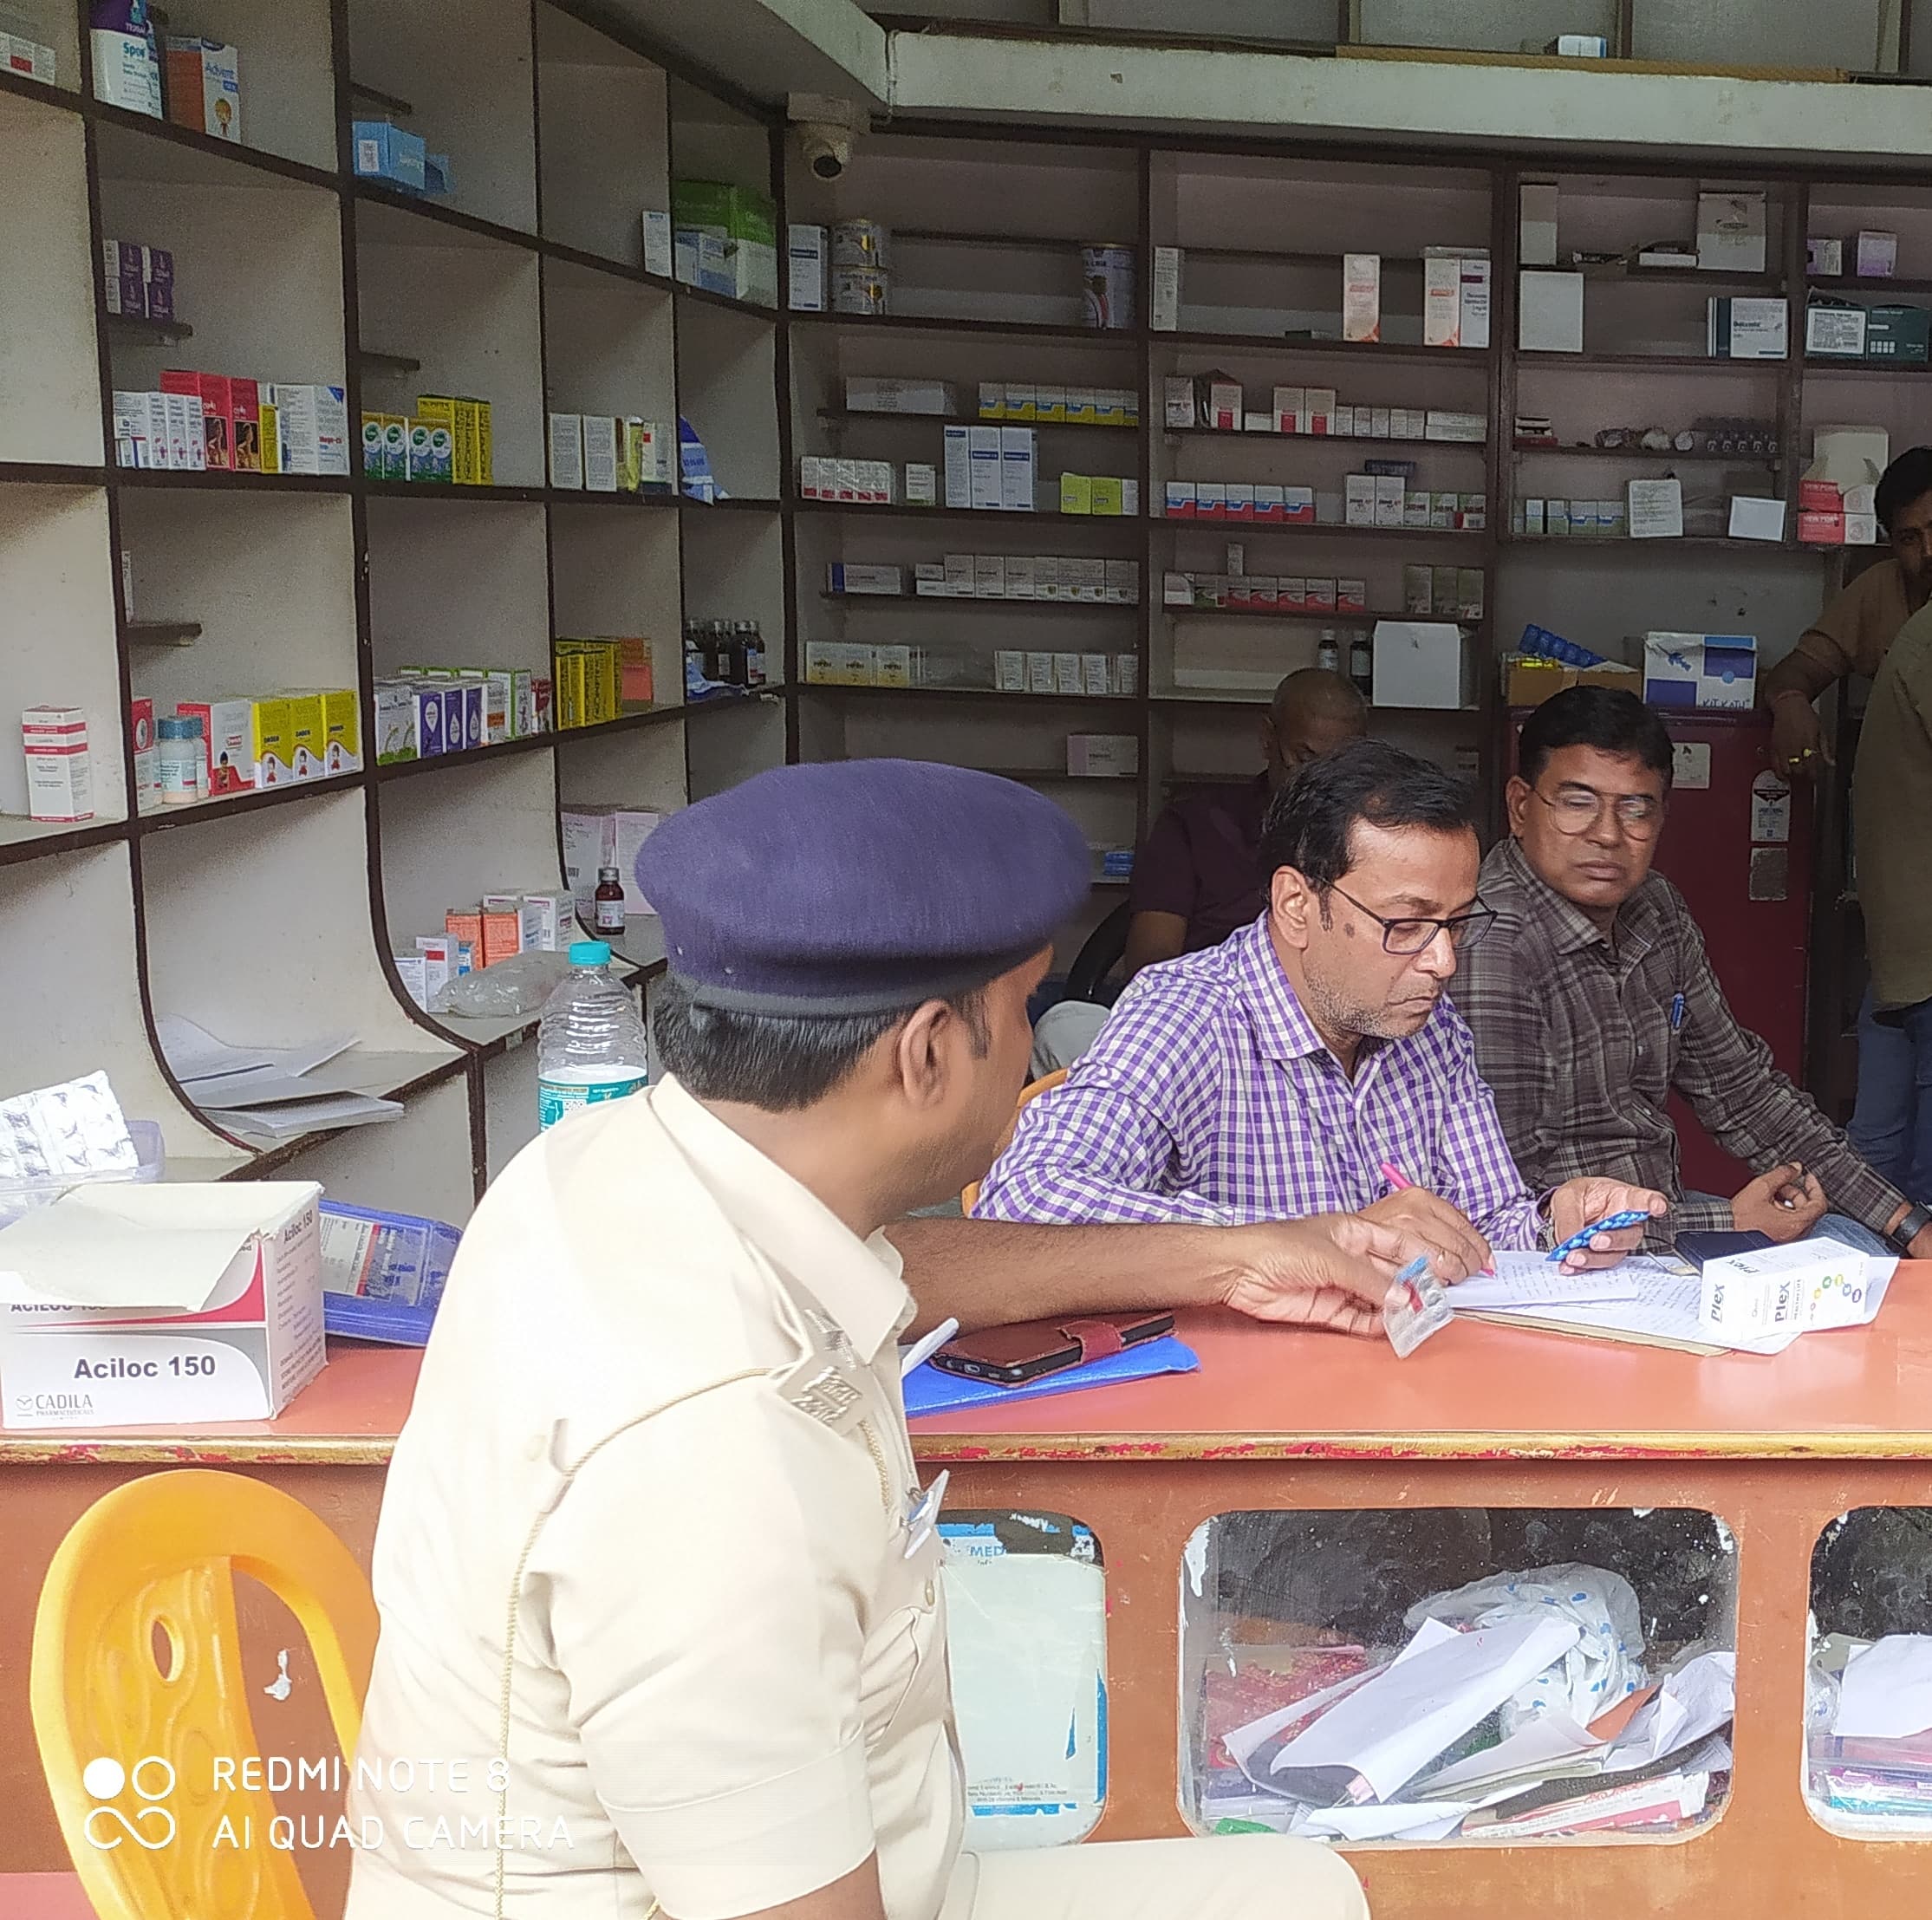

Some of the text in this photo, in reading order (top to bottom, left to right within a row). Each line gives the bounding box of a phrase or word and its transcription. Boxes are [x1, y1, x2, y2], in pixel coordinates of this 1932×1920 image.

[1710, 1284, 1725, 1324] Plex
[1775, 1281, 1791, 1322] Plex
[74, 1356, 216, 1378] Aciloc 150
[36, 1394, 93, 1409] CADILA
